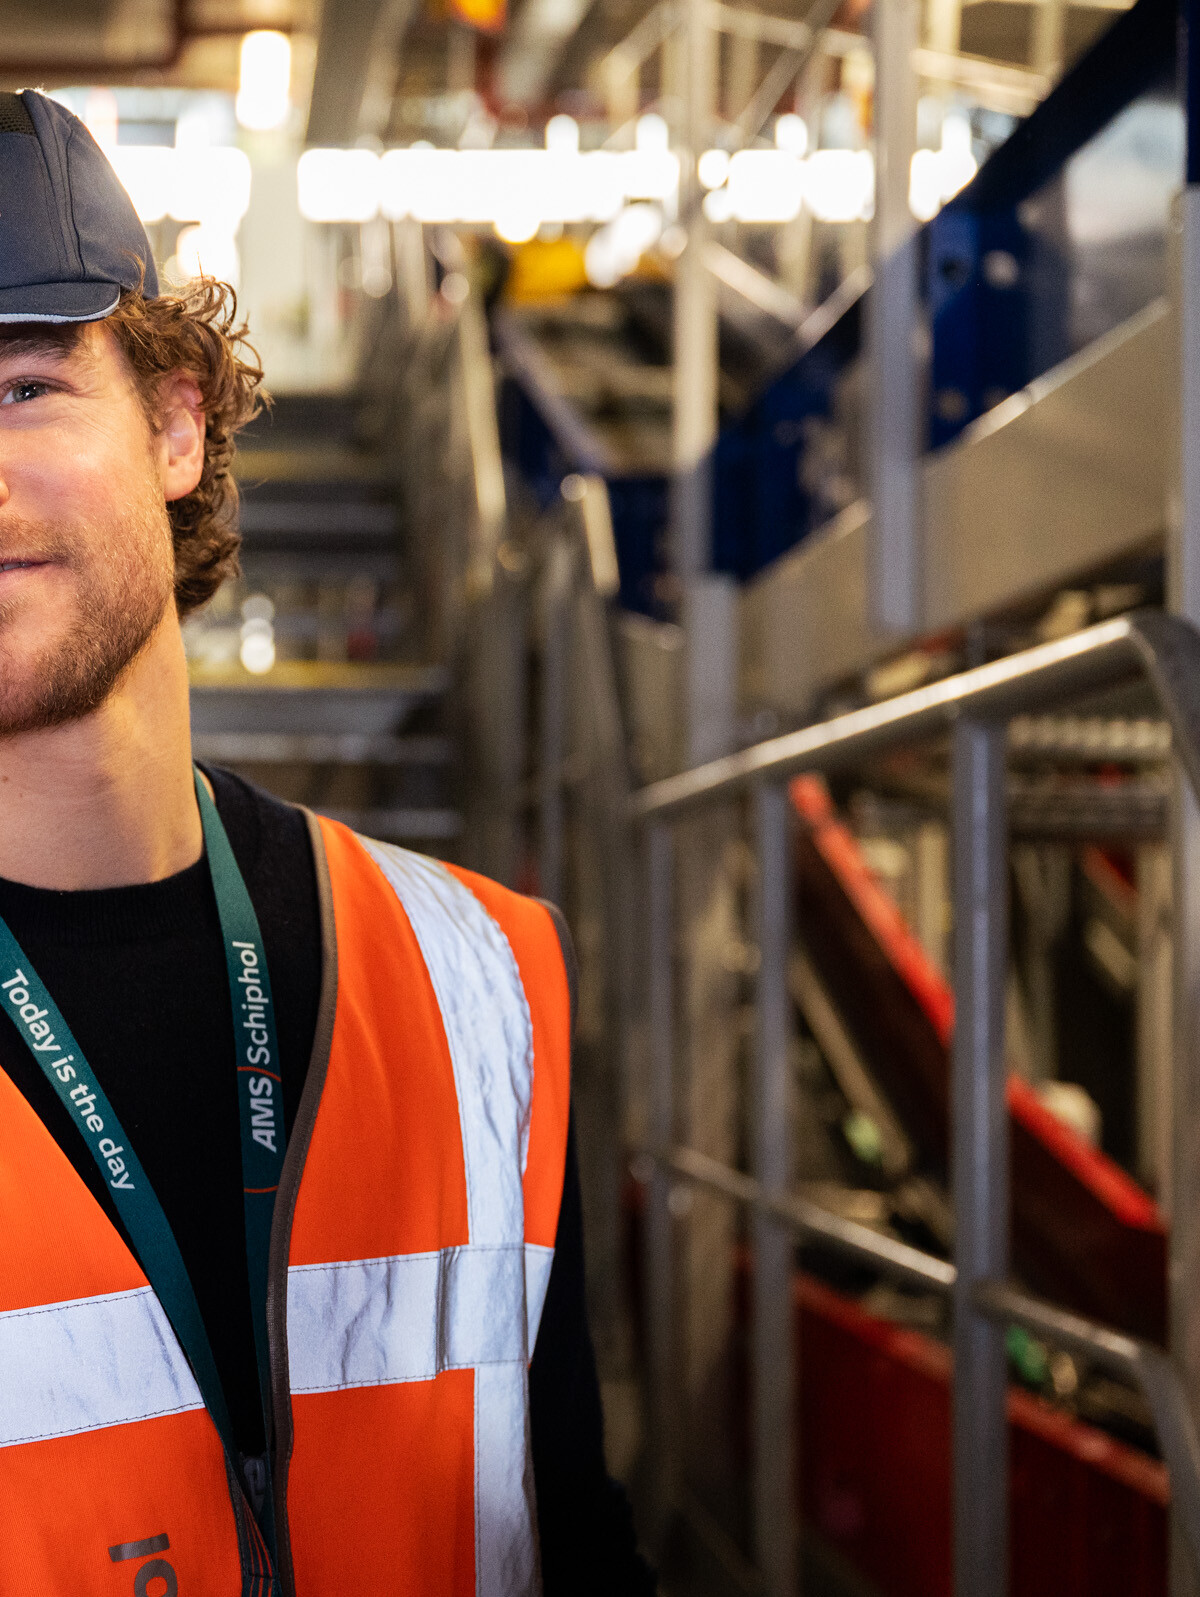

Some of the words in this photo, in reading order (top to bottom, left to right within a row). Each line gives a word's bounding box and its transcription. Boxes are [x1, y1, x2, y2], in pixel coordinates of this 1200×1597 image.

[232, 940, 270, 1065] Schiphol
[1, 968, 62, 1052] Today
[51, 1054, 77, 1083] is
[69, 1083, 104, 1133] the
[98, 1137, 135, 1190] day
[248, 1077, 277, 1153] AMS
